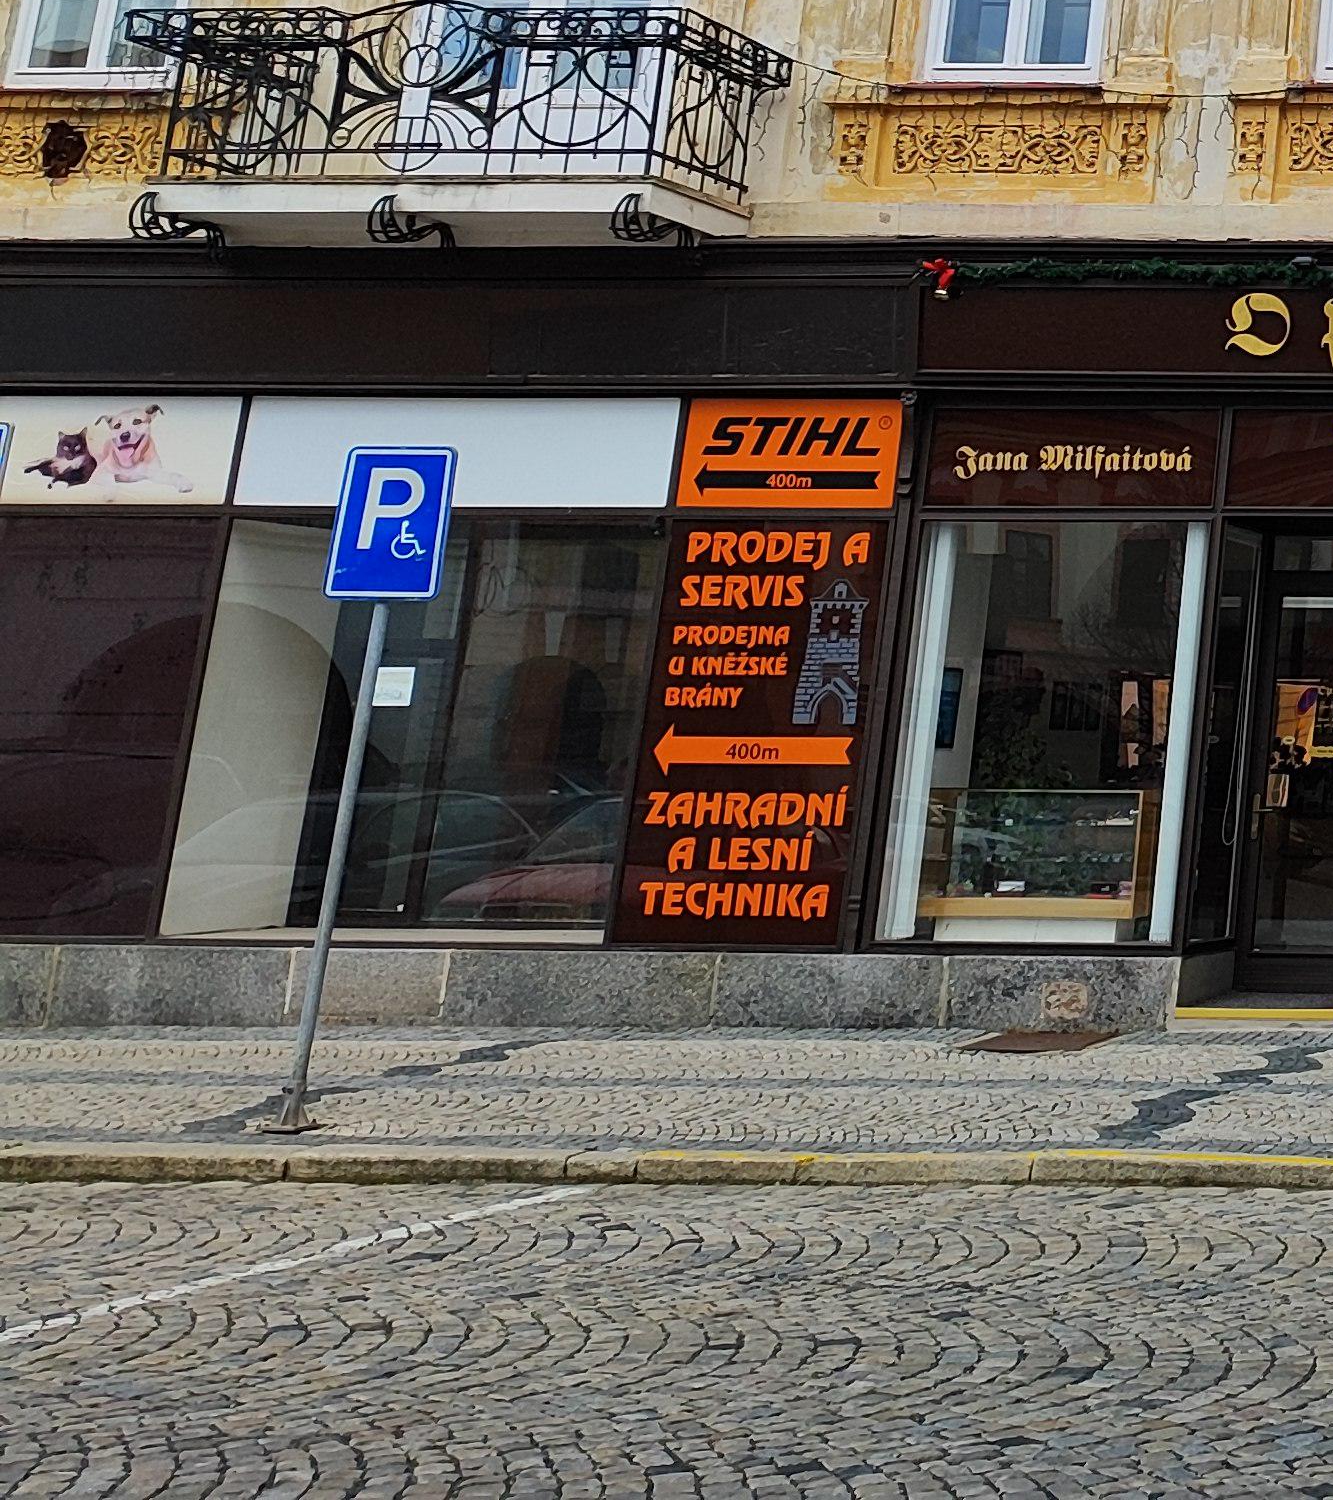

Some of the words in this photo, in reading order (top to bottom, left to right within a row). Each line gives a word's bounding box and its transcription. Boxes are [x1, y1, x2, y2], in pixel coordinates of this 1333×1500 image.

[701, 417, 880, 456] STIHL
[953, 445, 1029, 480] Jana
[765, 474, 812, 488] 400m
[356, 467, 425, 549] P
[686, 531, 832, 571] PRODEJ
[842, 532, 871, 566] A
[680, 575, 805, 610] SERVIS
[672, 625, 791, 648] PRODEJNA
[668, 656, 685, 675] U
[691, 652, 788, 676] KNĚŽSKÉ
[664, 682, 744, 708] BRÁNY
[725, 743, 780, 760] 400m
[644, 785, 849, 829] ZAHRADNÍ
[668, 837, 696, 873] A
[708, 830, 814, 872] LESNÍ
[639, 882, 830, 922] TECHNIKA
